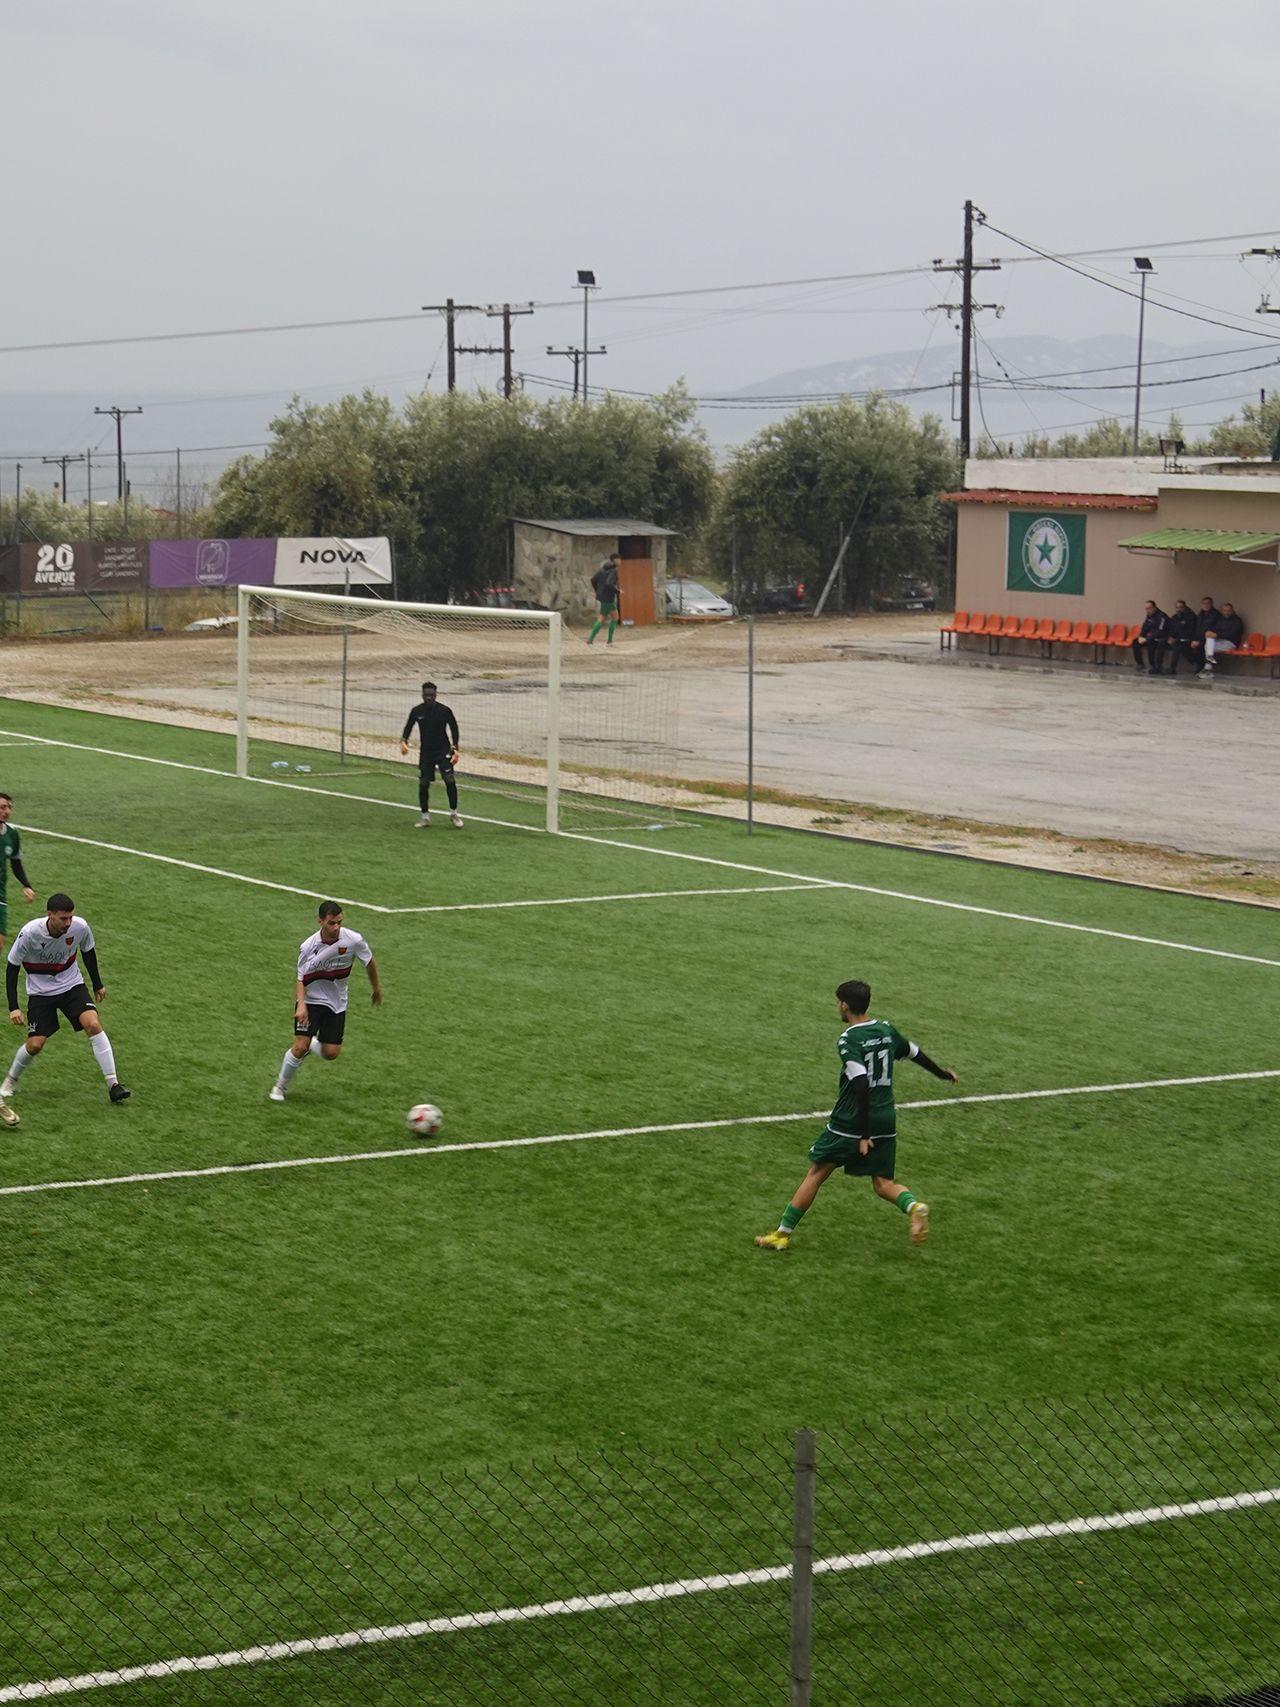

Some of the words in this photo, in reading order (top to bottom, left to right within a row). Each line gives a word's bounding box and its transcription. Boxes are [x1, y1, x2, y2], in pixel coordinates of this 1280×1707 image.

[37, 543, 74, 572] 20
[299, 549, 367, 564] NOVA
[34, 571, 76, 584] AVENUE
[864, 1048, 892, 1088] 11
